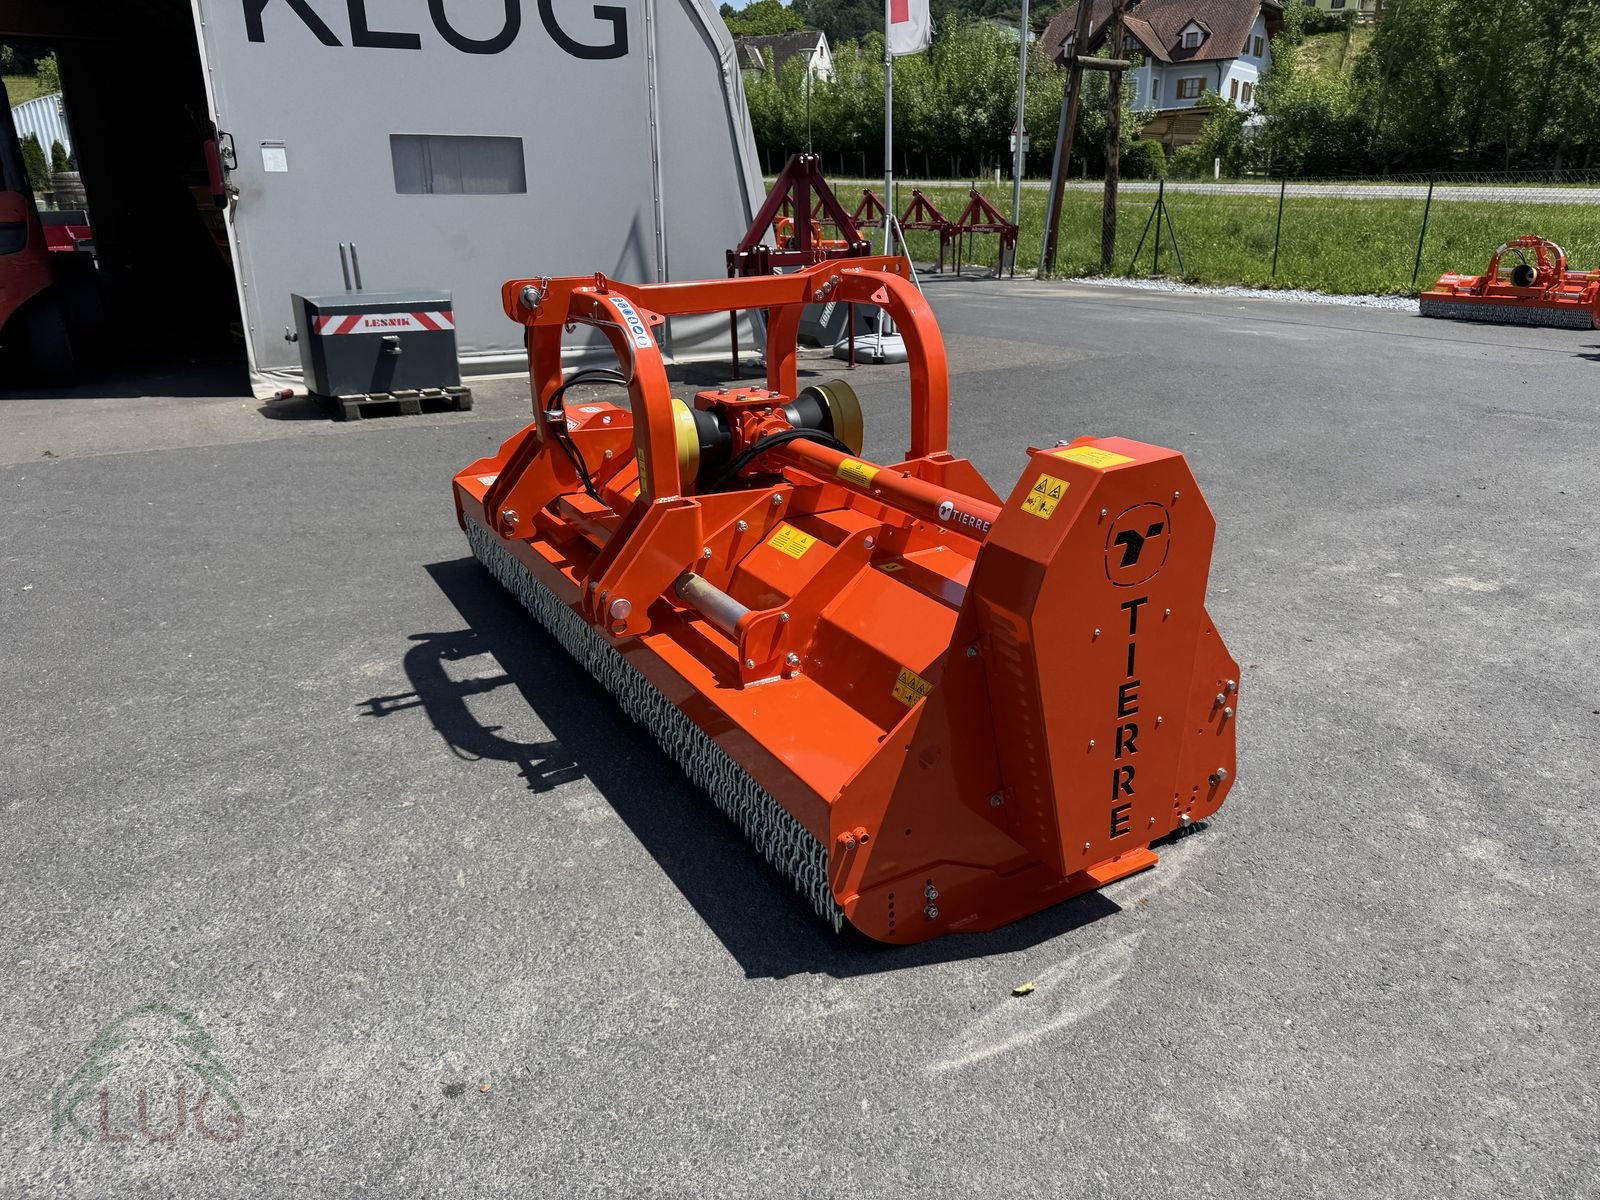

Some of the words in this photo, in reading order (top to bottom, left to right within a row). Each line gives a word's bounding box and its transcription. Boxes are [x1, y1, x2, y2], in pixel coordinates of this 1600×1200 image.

[364, 317, 410, 328] LESNIK
[952, 509, 991, 533] TIERRE
[1109, 596, 1149, 840] TIERRE
